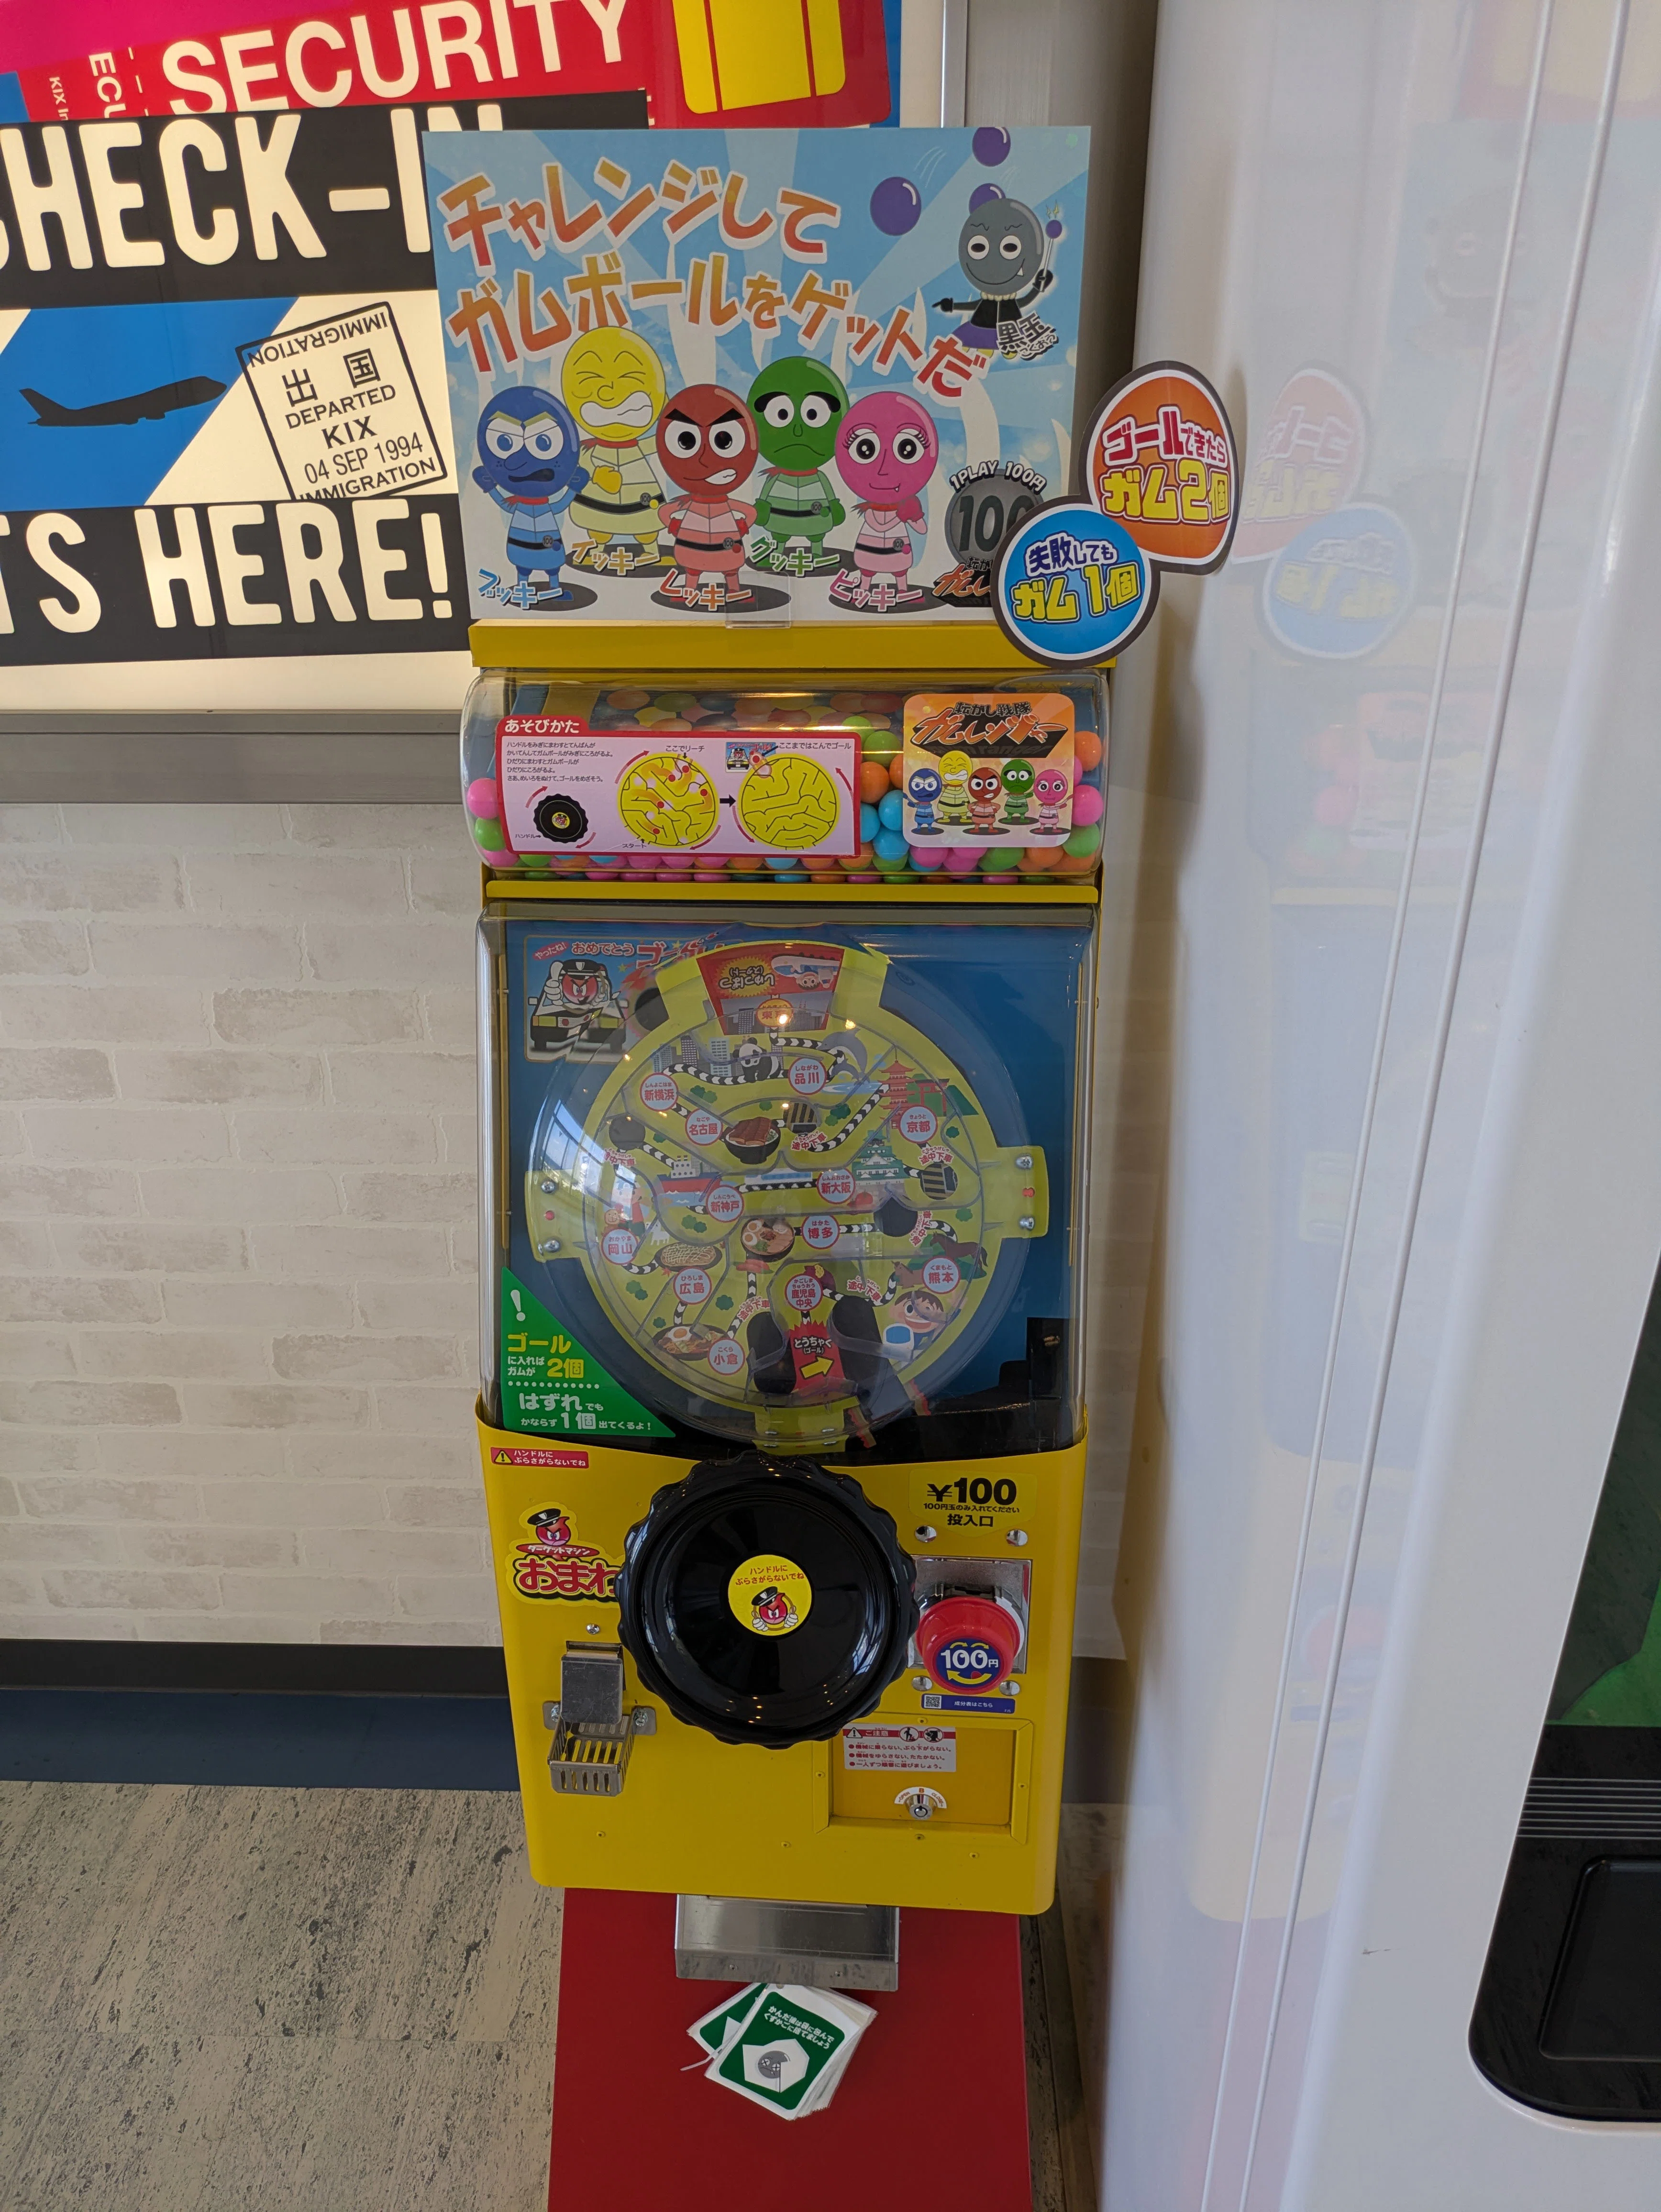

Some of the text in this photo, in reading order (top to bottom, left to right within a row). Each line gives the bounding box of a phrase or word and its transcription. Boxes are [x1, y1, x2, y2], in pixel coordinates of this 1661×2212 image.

[163, 0, 624, 114] SECURITY
[49, 77, 66, 105] KIX
[0, 104, 503, 271] HECK-I
[439, 158, 840, 269] チャレンジして
[445, 250, 989, 398] ガムボールをゲットだ
[997, 311, 1053, 353] 黒玉
[247, 312, 388, 368] IMMIGRATION
[281, 348, 381, 407] 出 国
[285, 385, 397, 430] DEPARTED
[321, 415, 377, 449] KIX
[1106, 410, 1227, 463] ゴールできたら
[304, 432, 423, 484] 04 SEP 1994
[950, 460, 1047, 492] 1PLAY 100円
[1103, 459, 1230, 521] ガム2個
[134, 498, 453, 628] HERE!
[572, 539, 660, 575] イッキー
[749, 535, 841, 576] グッキー
[966, 556, 993, 571] 転が
[1028, 538, 1115, 573] 失敗しても
[660, 569, 753, 611] レッキー
[830, 570, 923, 611] ピッキー
[1013, 563, 1140, 621] ガム1個
[953, 701, 1031, 717] 転がし戦隊
[505, 719, 579, 733] あそびかた
[535, 942, 567, 960] やったね!
[571, 941, 635, 956] おめでとう
[719, 973, 775, 989] しゅっぱつ
[794, 1072, 819, 1084] 品川
[644, 1089, 675, 1101] 新横浜
[688, 1123, 718, 1136] 名古屋
[906, 1120, 931, 1133] 京都
[919, 1151, 953, 1165] 途中下車
[820, 1182, 851, 1194] 新大阪
[710, 1200, 740, 1213] 新神戸
[808, 1227, 833, 1239] 博多
[608, 1243, 633, 1256] 岡山
[928, 1272, 954, 1284] 熊本
[679, 1282, 705, 1294] 広島
[791, 1289, 816, 1299] 鹿児島
[796, 1299, 813, 1308] 中央
[508, 1332, 571, 1354] ゴール
[794, 1336, 832, 1349] とうちゃく
[508, 1356, 545, 1366] に入れば
[713, 1353, 738, 1365] 小倉
[507, 1358, 584, 1378] ガムが 2個
[514, 1457, 586, 1466] ぶらさがらないでね
[927, 1477, 1017, 1505] ¥100
[923, 1503, 1020, 1513] 100円玉のみ入れてください
[947, 1514, 994, 1527] 投入口
[528, 1545, 590, 1555] ターゲットマシン
[750, 1565, 788, 1575] ハンドルに
[735, 1572, 805, 1586] ぶらさがらないでね
[941, 1649, 999, 1669] 100円
